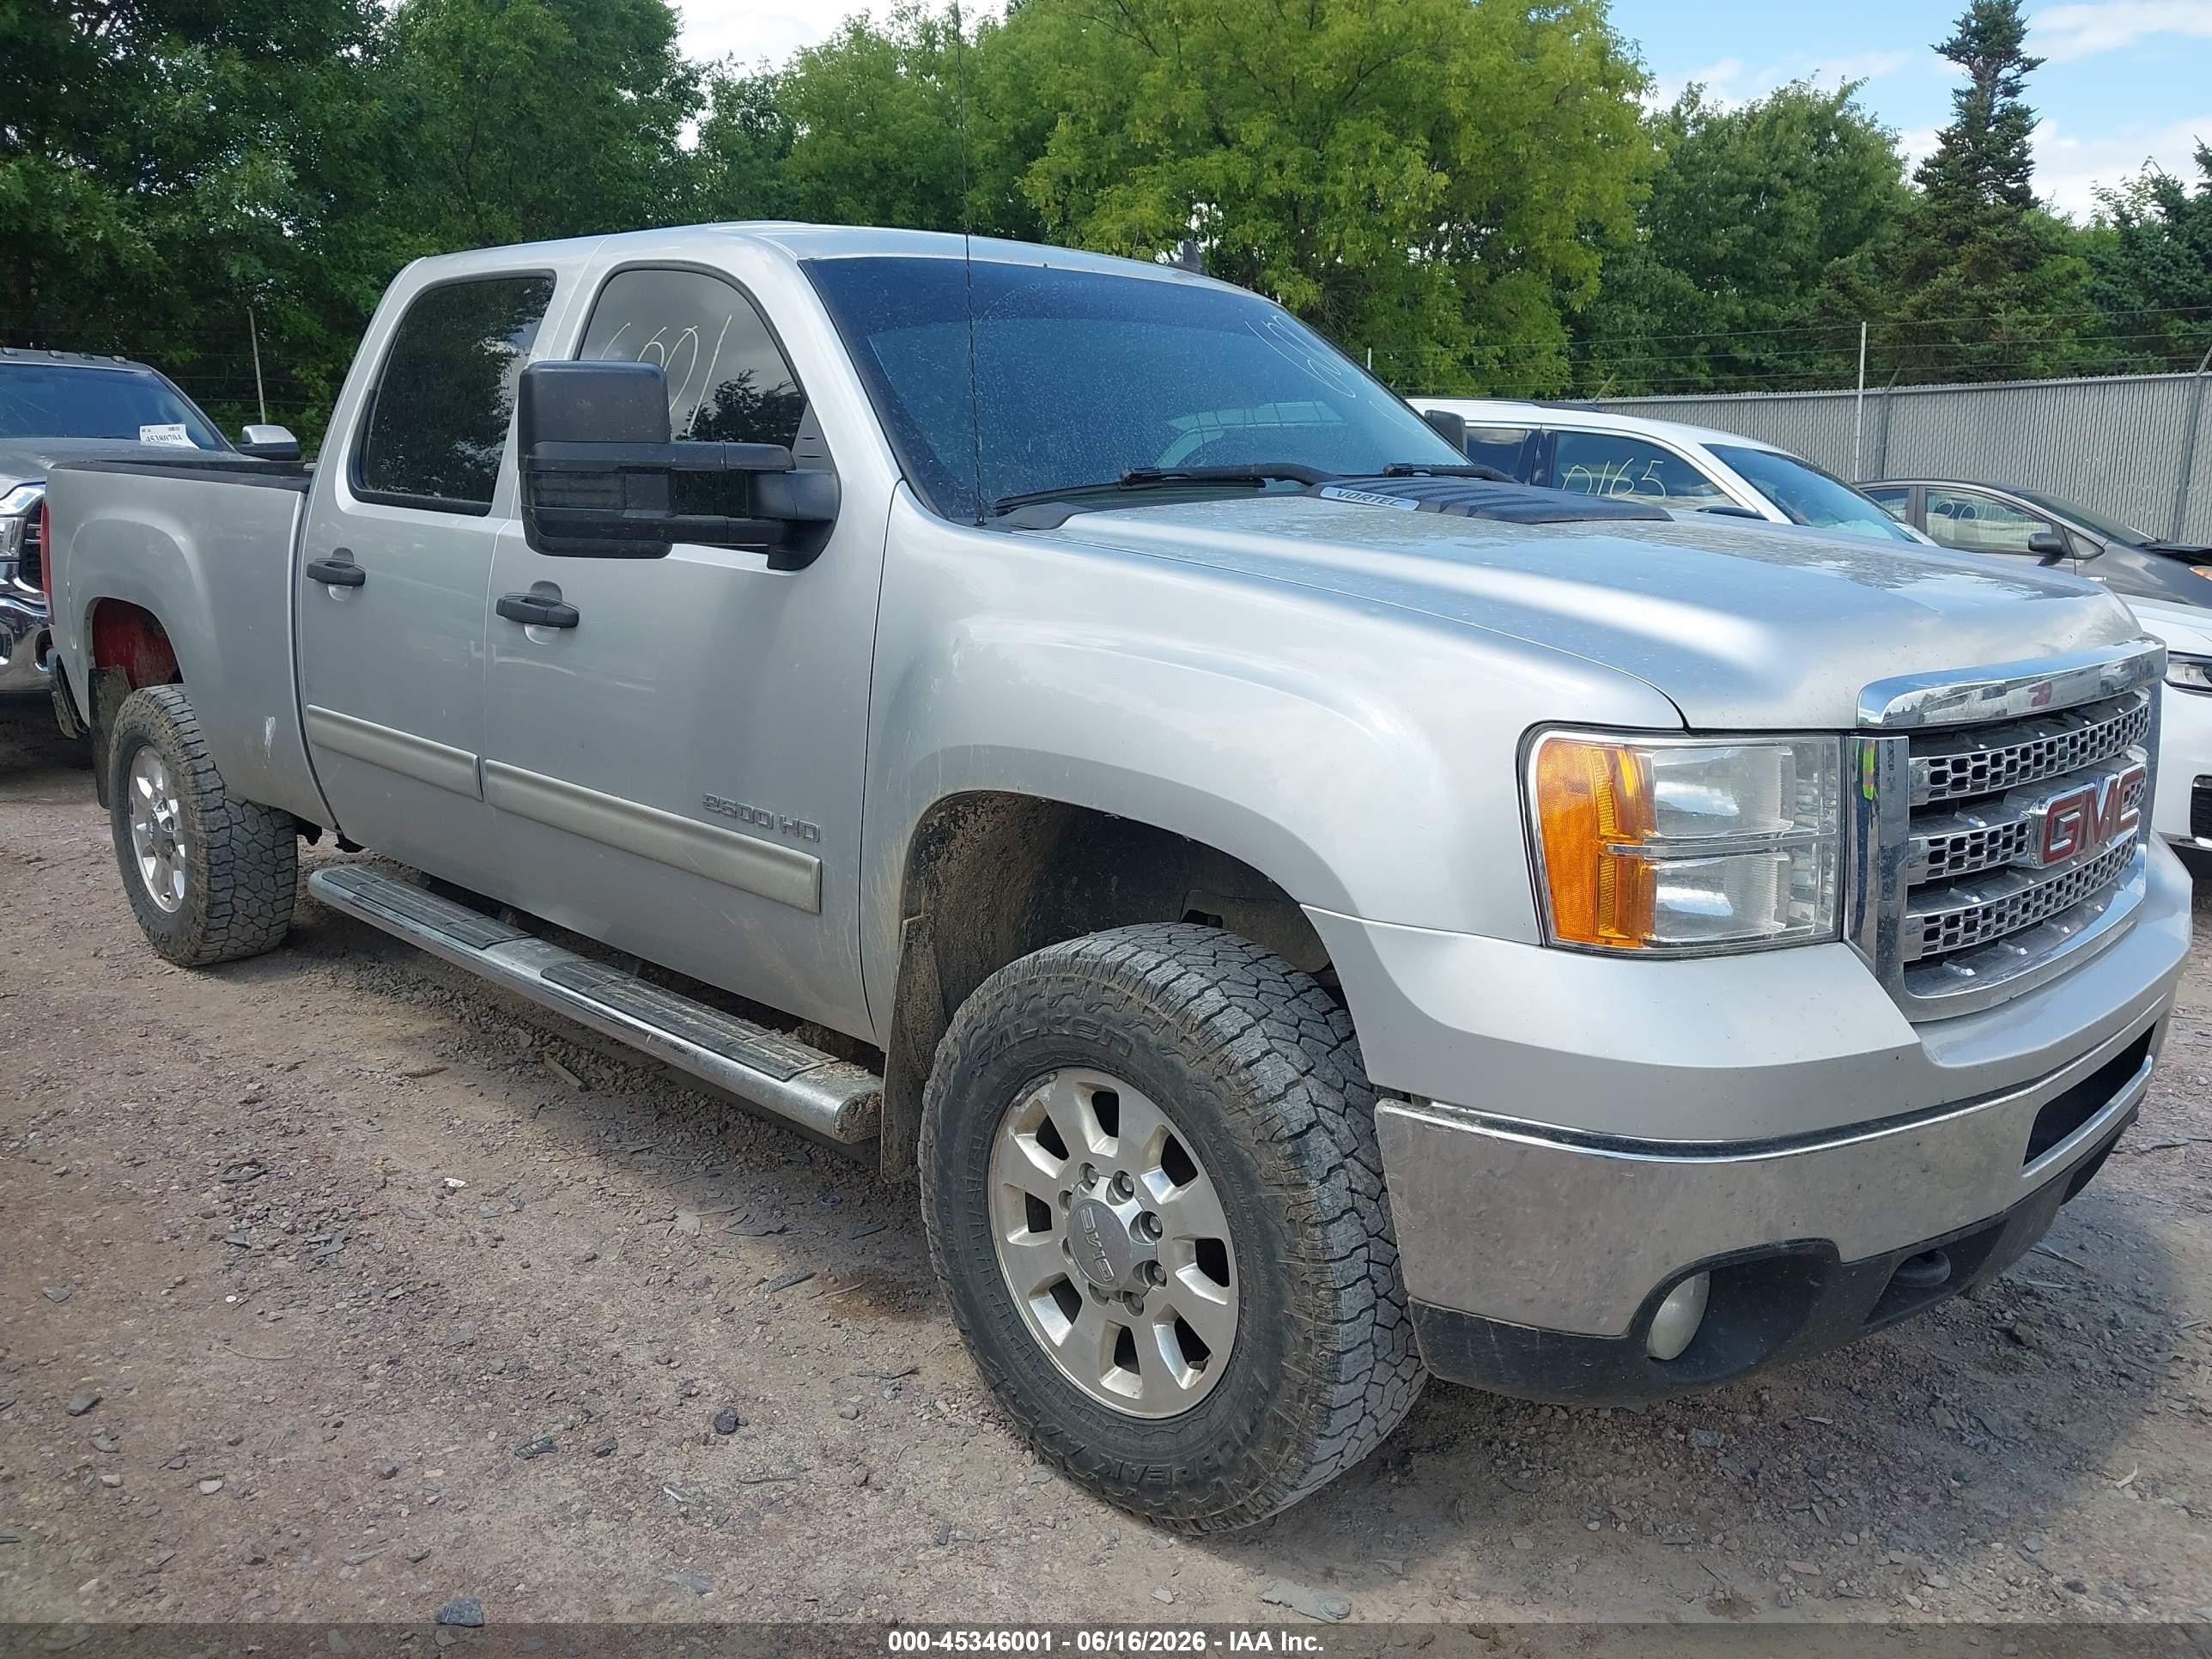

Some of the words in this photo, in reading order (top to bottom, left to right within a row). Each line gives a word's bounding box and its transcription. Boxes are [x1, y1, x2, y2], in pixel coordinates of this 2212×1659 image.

[1336, 489, 1407, 506] VORTEC
[703, 793, 774, 830] 2500
[779, 814, 821, 842] HD
[2042, 763, 2146, 865] GMC
[975, 1016, 1133, 1079] FALKEN
[1080, 1206, 1115, 1282] GMC
